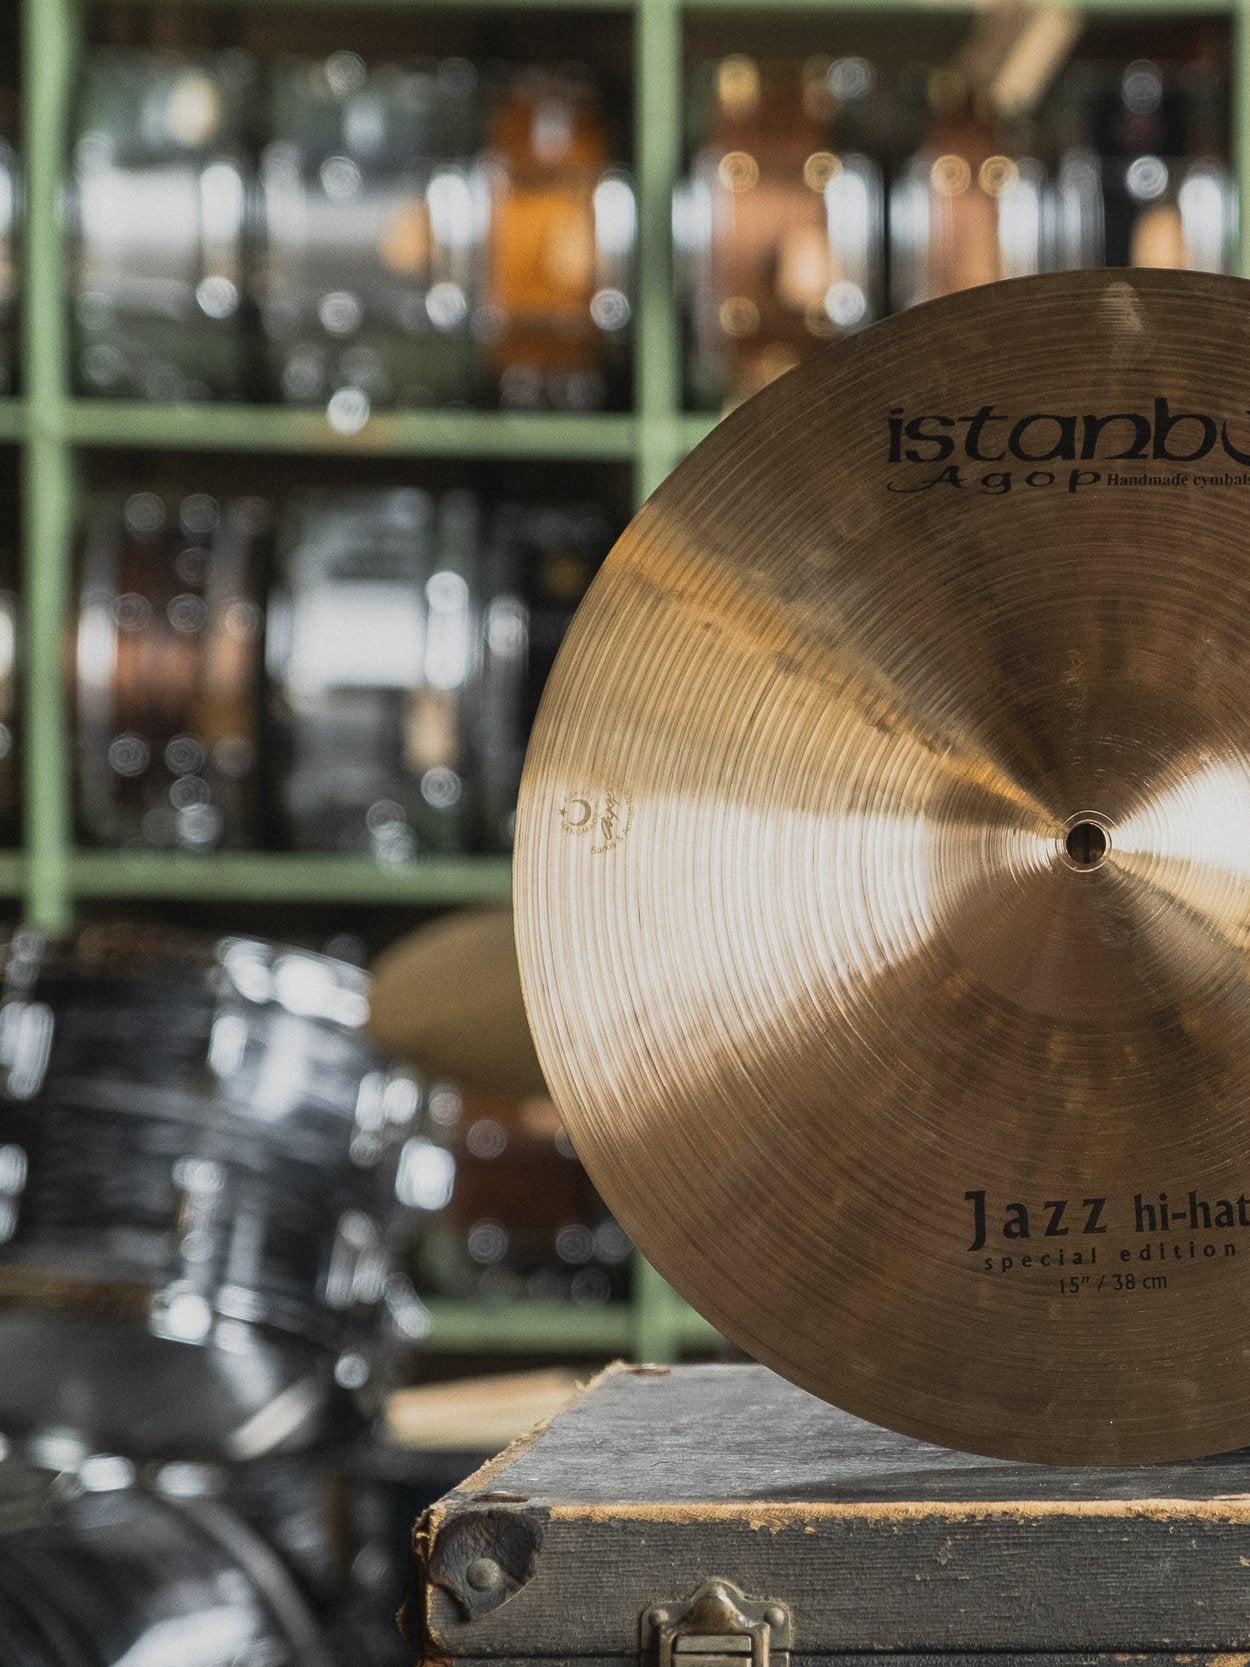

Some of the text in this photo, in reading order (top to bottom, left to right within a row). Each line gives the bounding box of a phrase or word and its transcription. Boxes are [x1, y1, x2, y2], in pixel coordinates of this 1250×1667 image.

[887, 465, 1101, 495] Agop
[1107, 473, 1188, 486] Handmade
[964, 1190, 1107, 1251] Jazz
[984, 1241, 1237, 1272] special edition
[1113, 1275, 1136, 1291] 38
[1142, 1274, 1168, 1289] cm
